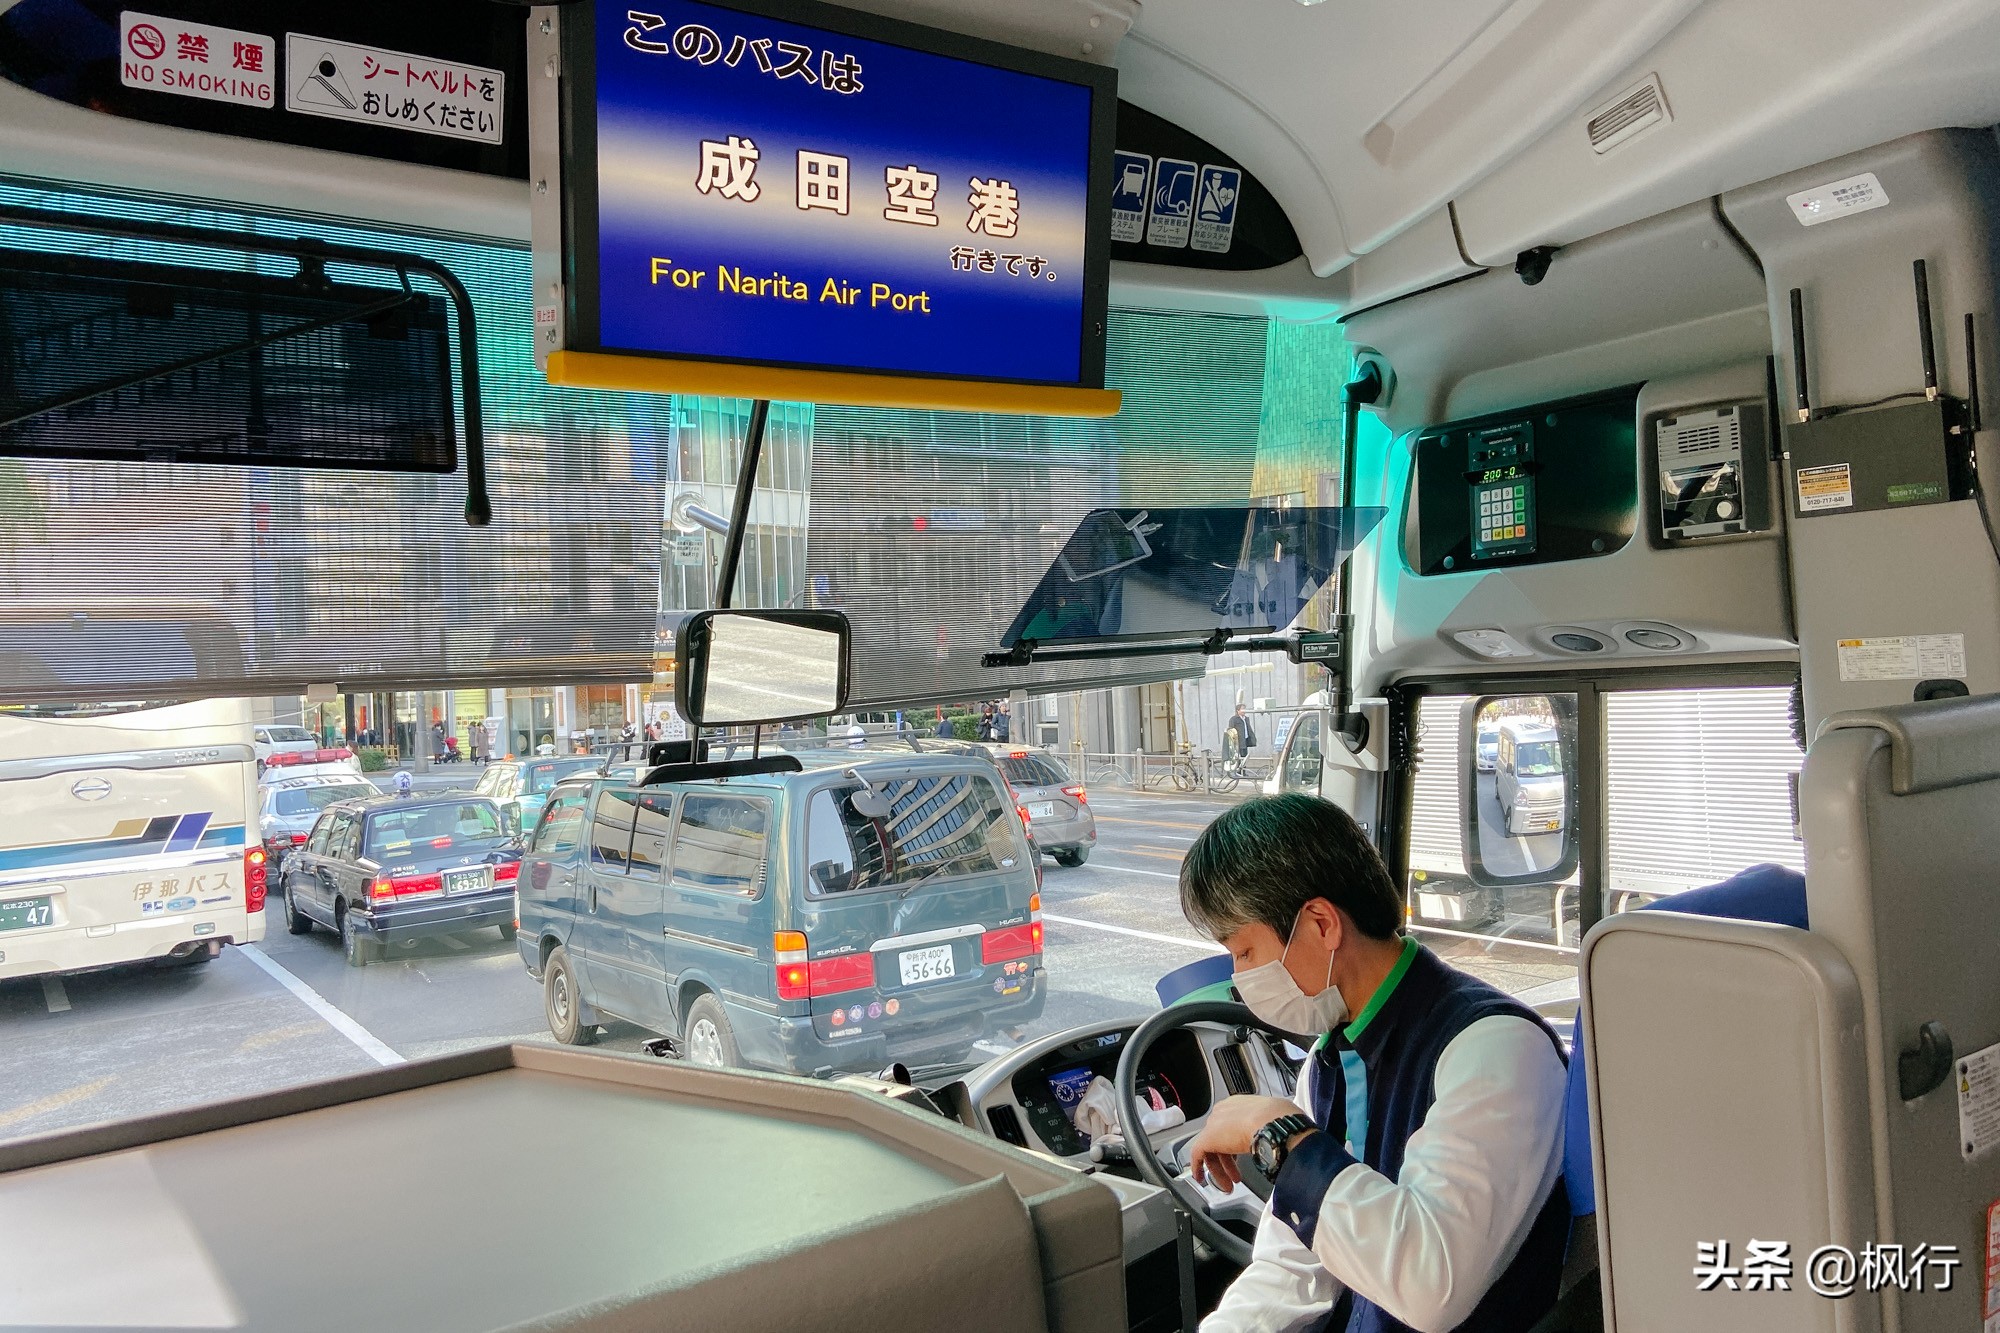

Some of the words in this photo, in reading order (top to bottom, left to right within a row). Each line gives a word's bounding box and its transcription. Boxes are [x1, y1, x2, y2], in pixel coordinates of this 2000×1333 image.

[176, 31, 264, 73] 禁煙
[624, 10, 863, 94] このバスは
[125, 62, 154, 83] NO
[162, 67, 271, 101] SMOKING
[363, 56, 495, 101] シートベルトを
[362, 90, 495, 134] おしめください
[696, 135, 1019, 239] 成田空港
[1157, 226, 1180, 234] ブレーキ
[1194, 230, 1229, 241] 対応システム
[951, 245, 1057, 281] 行きです。
[650, 258, 705, 291] For
[718, 267, 808, 302] Narita
[819, 277, 862, 306] Air
[871, 283, 931, 313] Port
[132, 872, 231, 901] 伊那バス
[458, 876, 484, 890] 69-21
[999, 917, 1024, 926] HIACE
[912, 958, 952, 980] 56-66
[928, 949, 942, 958] 400
[1037, 1107, 1048, 1115] 100
